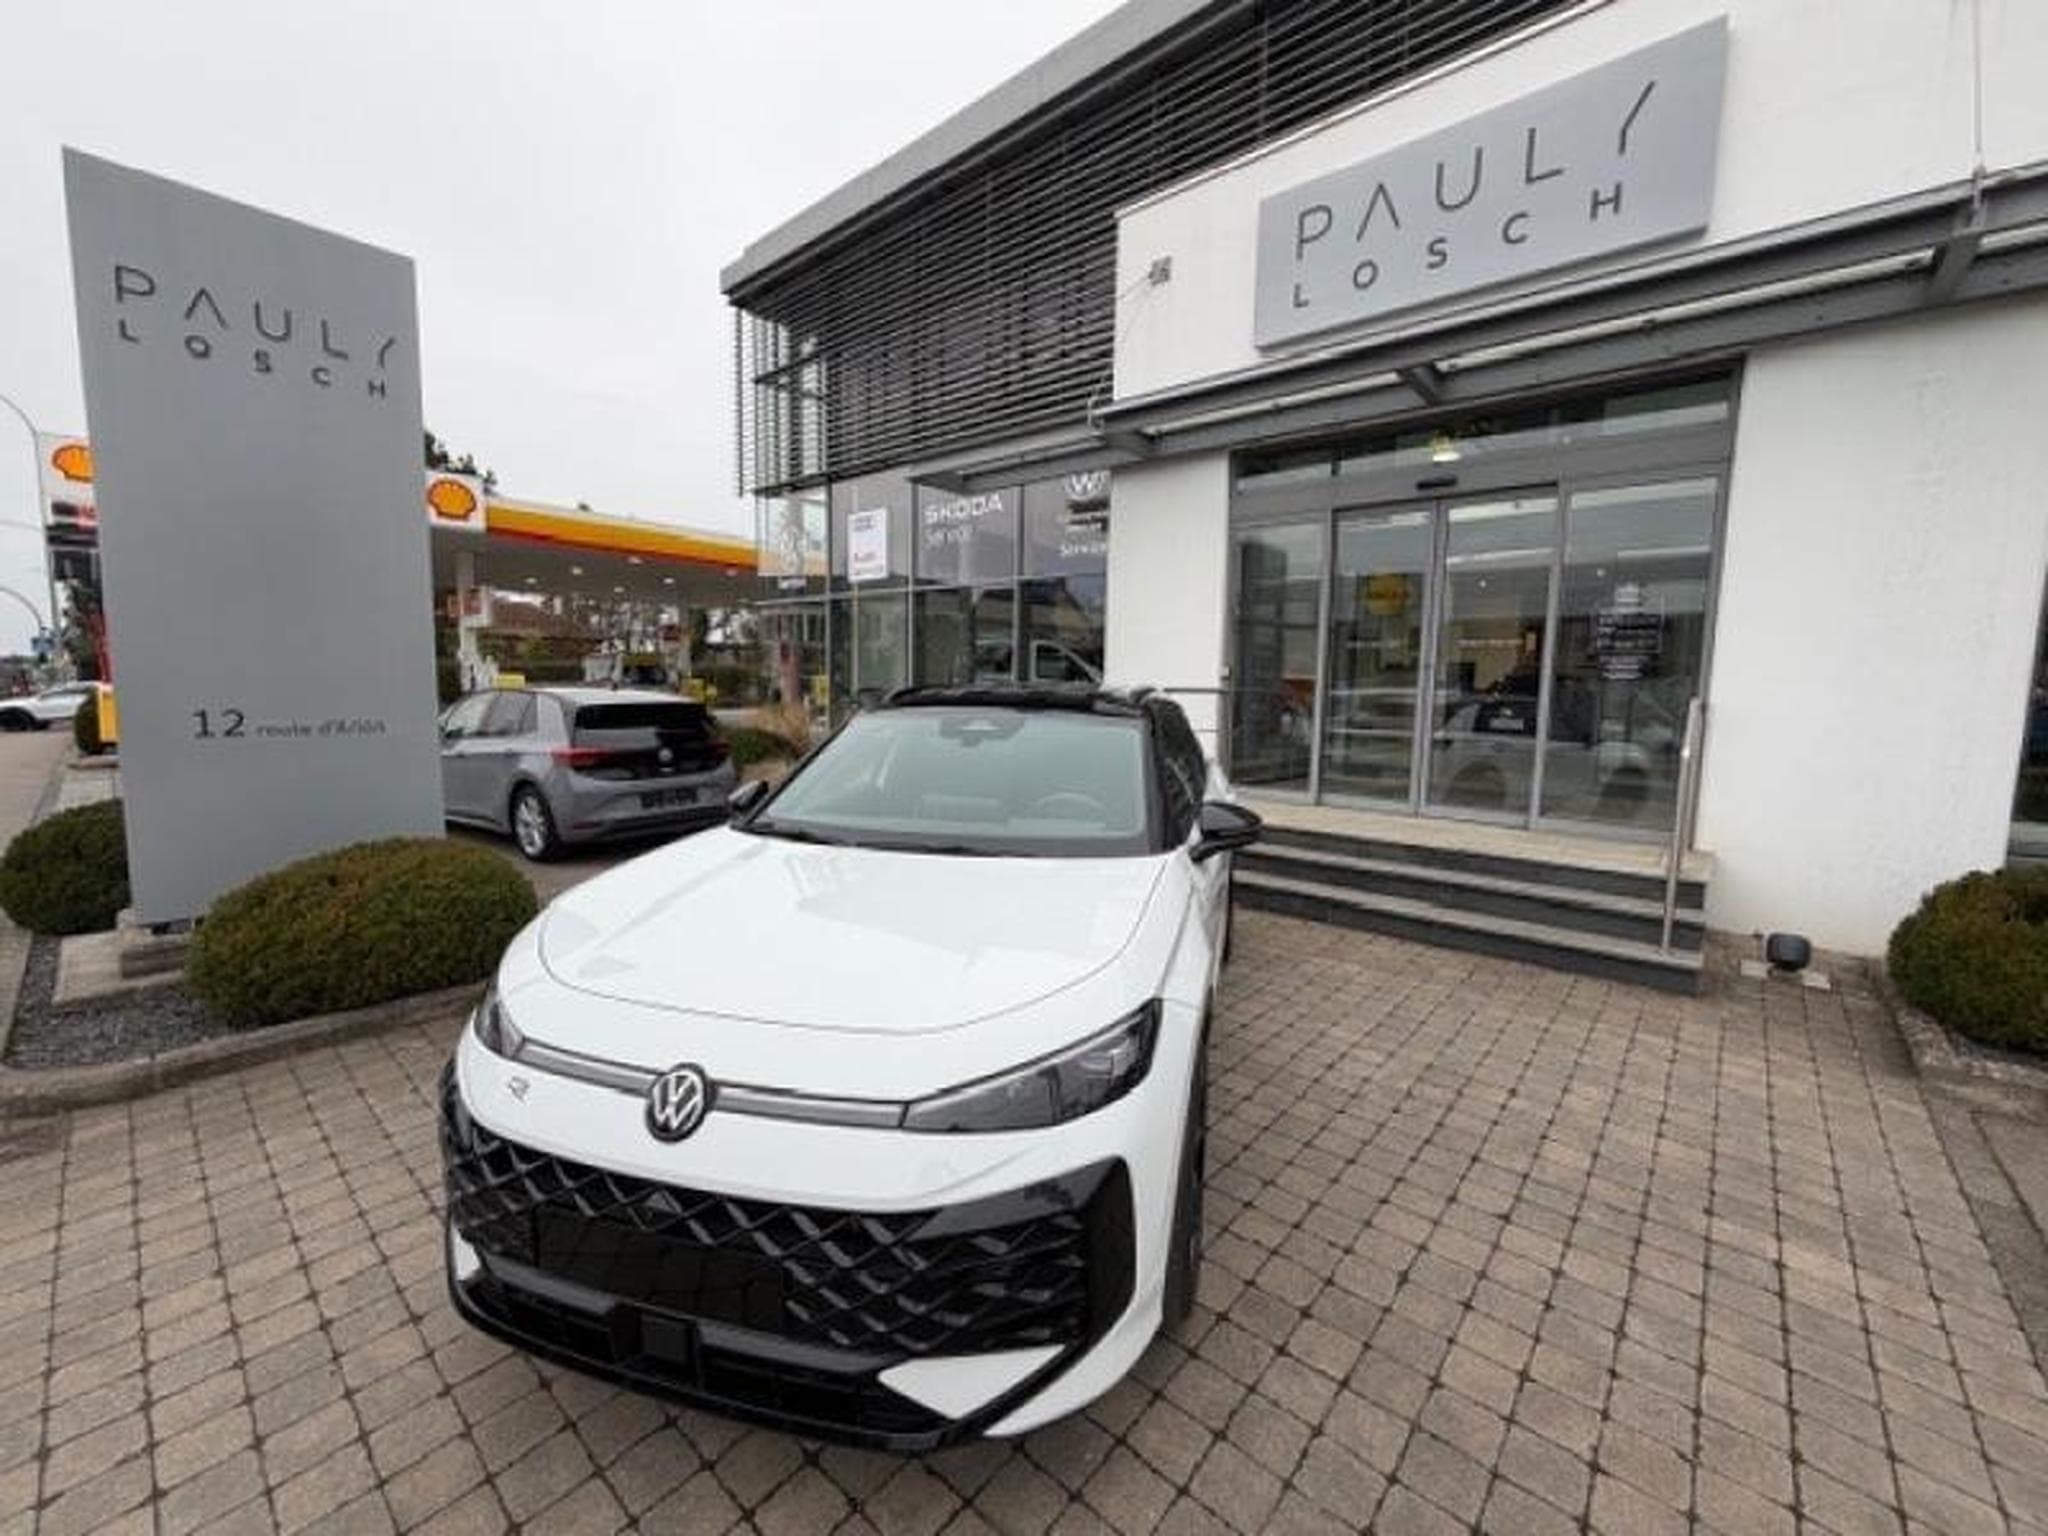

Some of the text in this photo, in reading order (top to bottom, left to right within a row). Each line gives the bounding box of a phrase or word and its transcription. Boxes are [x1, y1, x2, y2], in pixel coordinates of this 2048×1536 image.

[1294, 80, 1657, 261] PAULY
[1293, 183, 1624, 309] LOSCH
[114, 264, 397, 369] PAULY
[118, 318, 387, 400] LOSCH
[192, 708, 246, 739] 12
